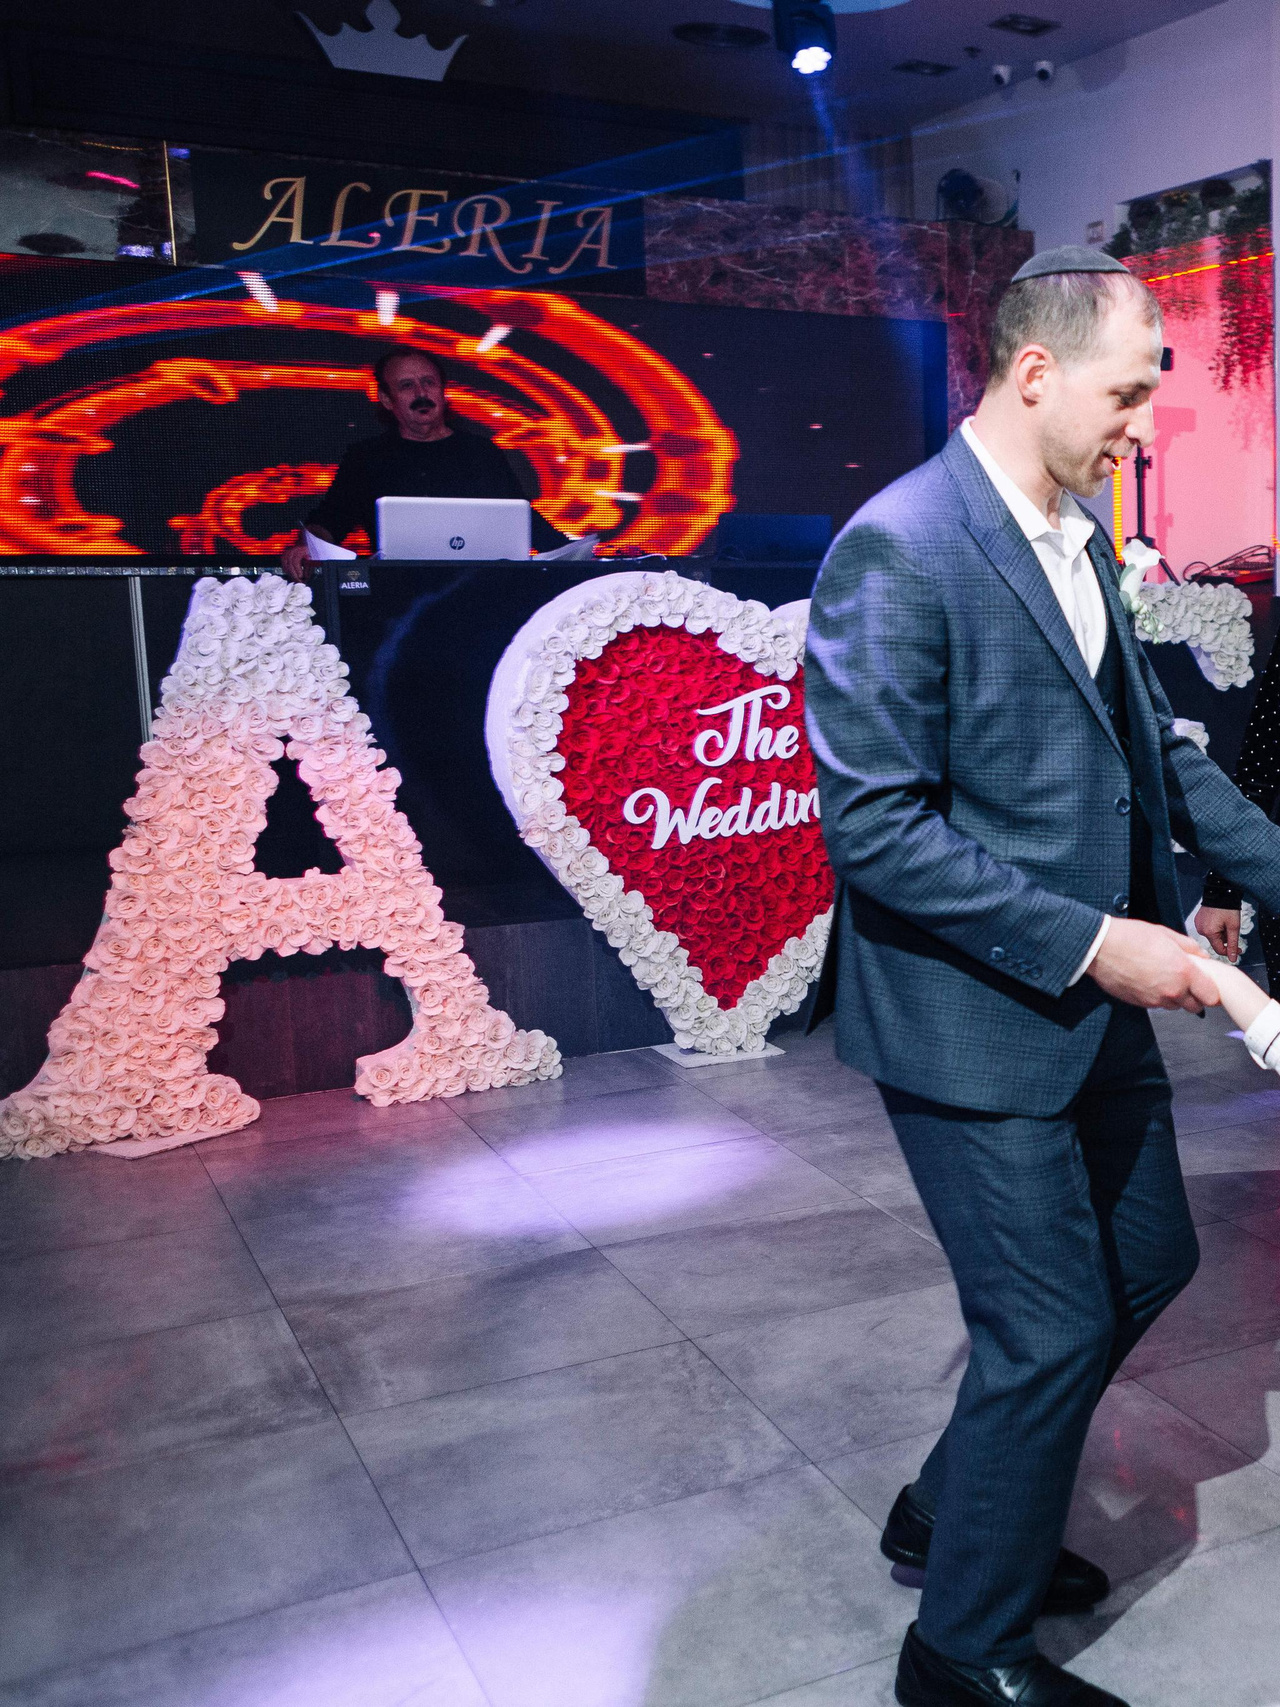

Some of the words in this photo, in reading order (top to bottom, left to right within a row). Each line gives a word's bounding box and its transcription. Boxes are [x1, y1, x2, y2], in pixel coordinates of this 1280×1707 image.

[232, 176, 618, 275] ALERIA
[451, 537, 465, 550] hp
[341, 581, 369, 590] ALERIA
[694, 685, 799, 767] The
[623, 777, 821, 850] Weddin
